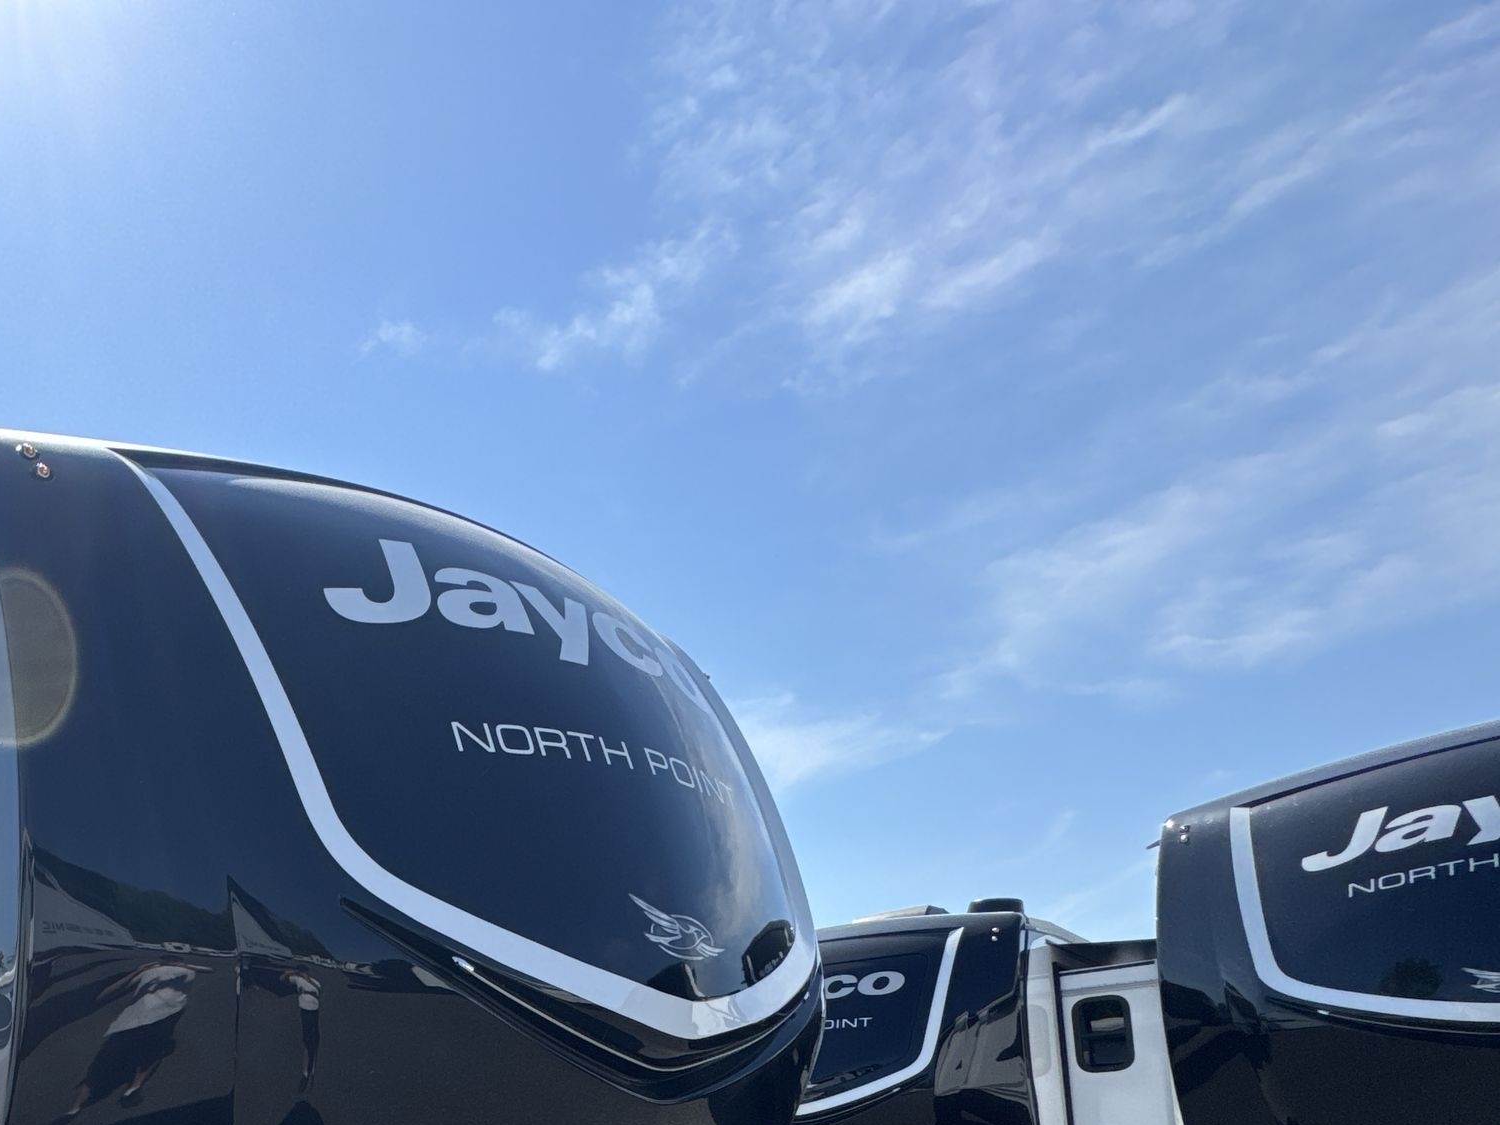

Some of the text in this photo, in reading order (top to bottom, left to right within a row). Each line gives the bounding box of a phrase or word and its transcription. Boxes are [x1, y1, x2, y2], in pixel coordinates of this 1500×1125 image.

[324, 539, 711, 714] Jayco
[451, 721, 735, 809] NORTH POINT
[1348, 853, 1500, 898] NORTH
[824, 1017, 873, 1030] OINT
